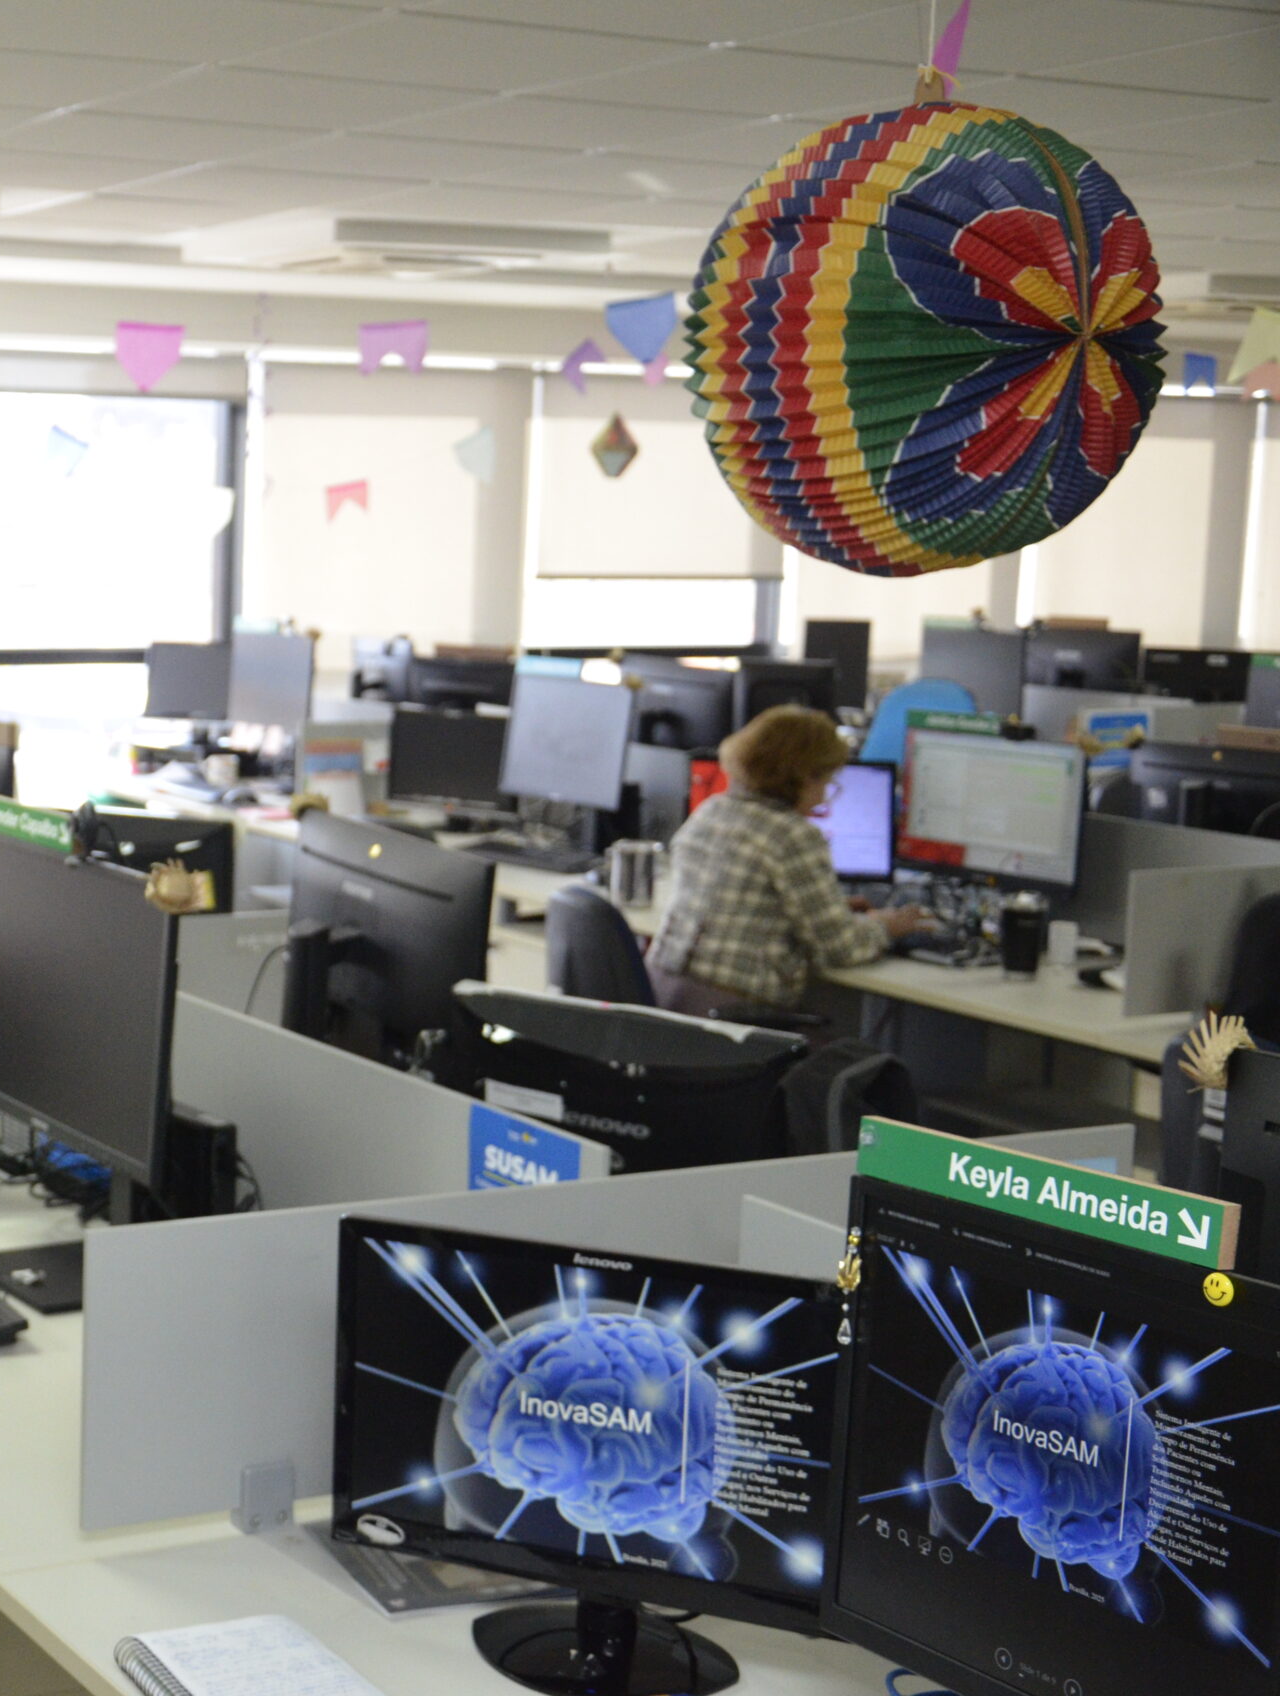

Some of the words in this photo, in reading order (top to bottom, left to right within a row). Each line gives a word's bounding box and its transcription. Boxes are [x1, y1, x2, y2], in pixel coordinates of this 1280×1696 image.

[562, 1111, 651, 1140] enovo
[484, 1144, 560, 1186] SUSAM
[948, 1151, 1030, 1199] Keyla
[1036, 1175, 1169, 1237] Almeida
[573, 1252, 634, 1271] lenovo
[519, 1390, 653, 1435] InovaSAM
[993, 1409, 1100, 1468] InovaSAM
